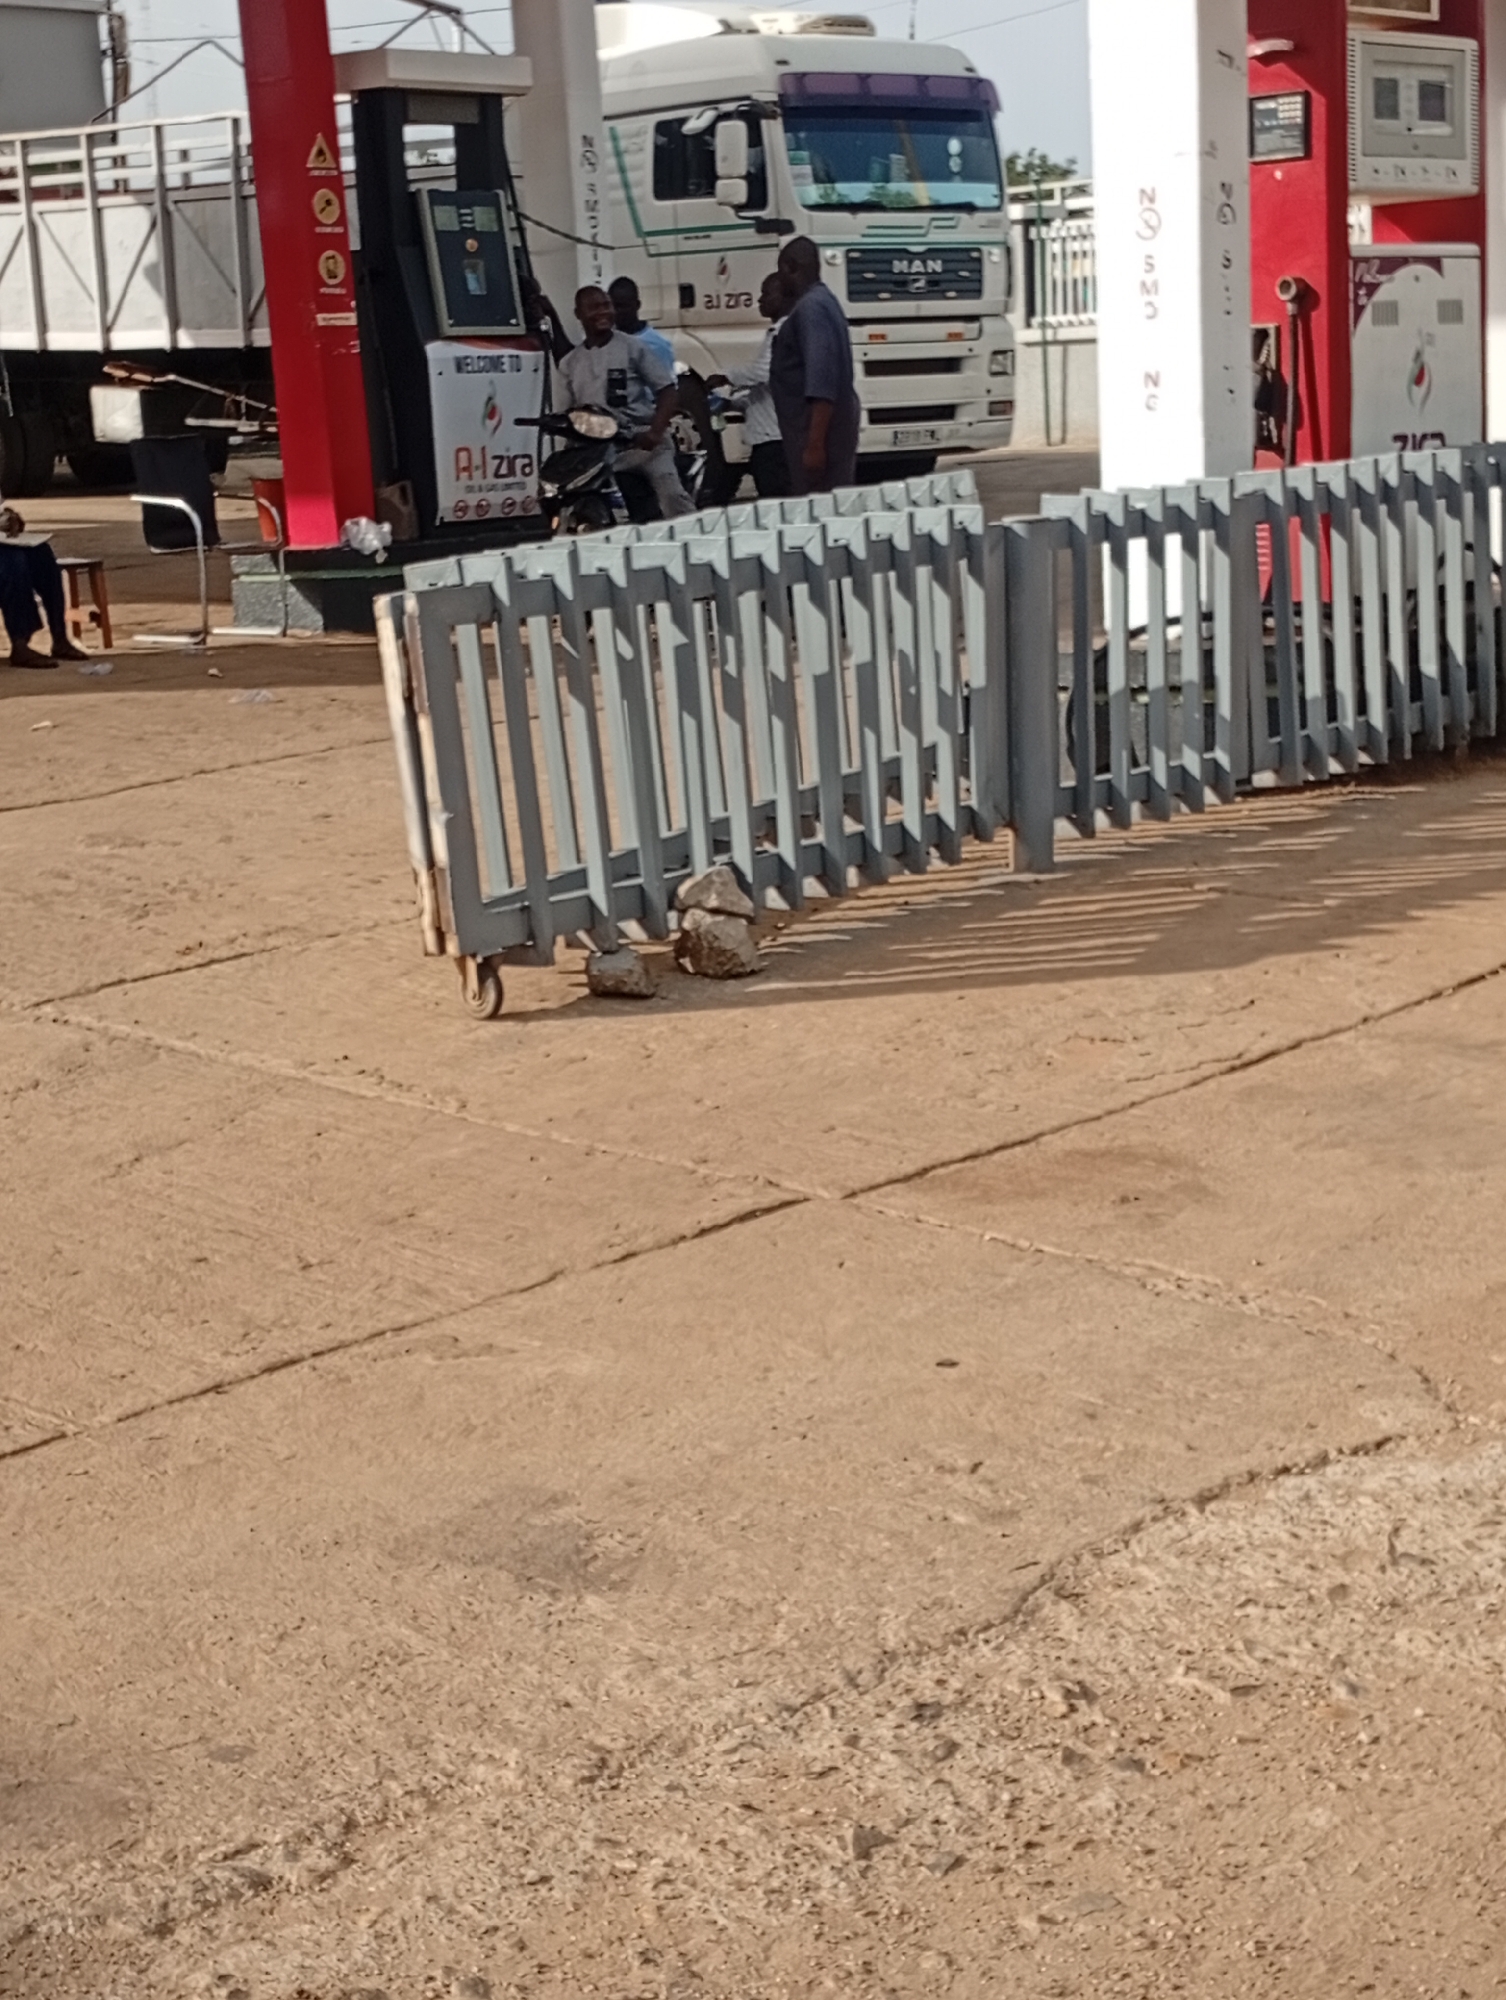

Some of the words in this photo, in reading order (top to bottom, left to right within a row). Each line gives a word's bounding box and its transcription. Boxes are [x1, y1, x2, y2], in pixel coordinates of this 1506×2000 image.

[892, 259, 943, 273] MAN
[454, 355, 507, 374] WELCOME
[508, 354, 522, 373] TO
